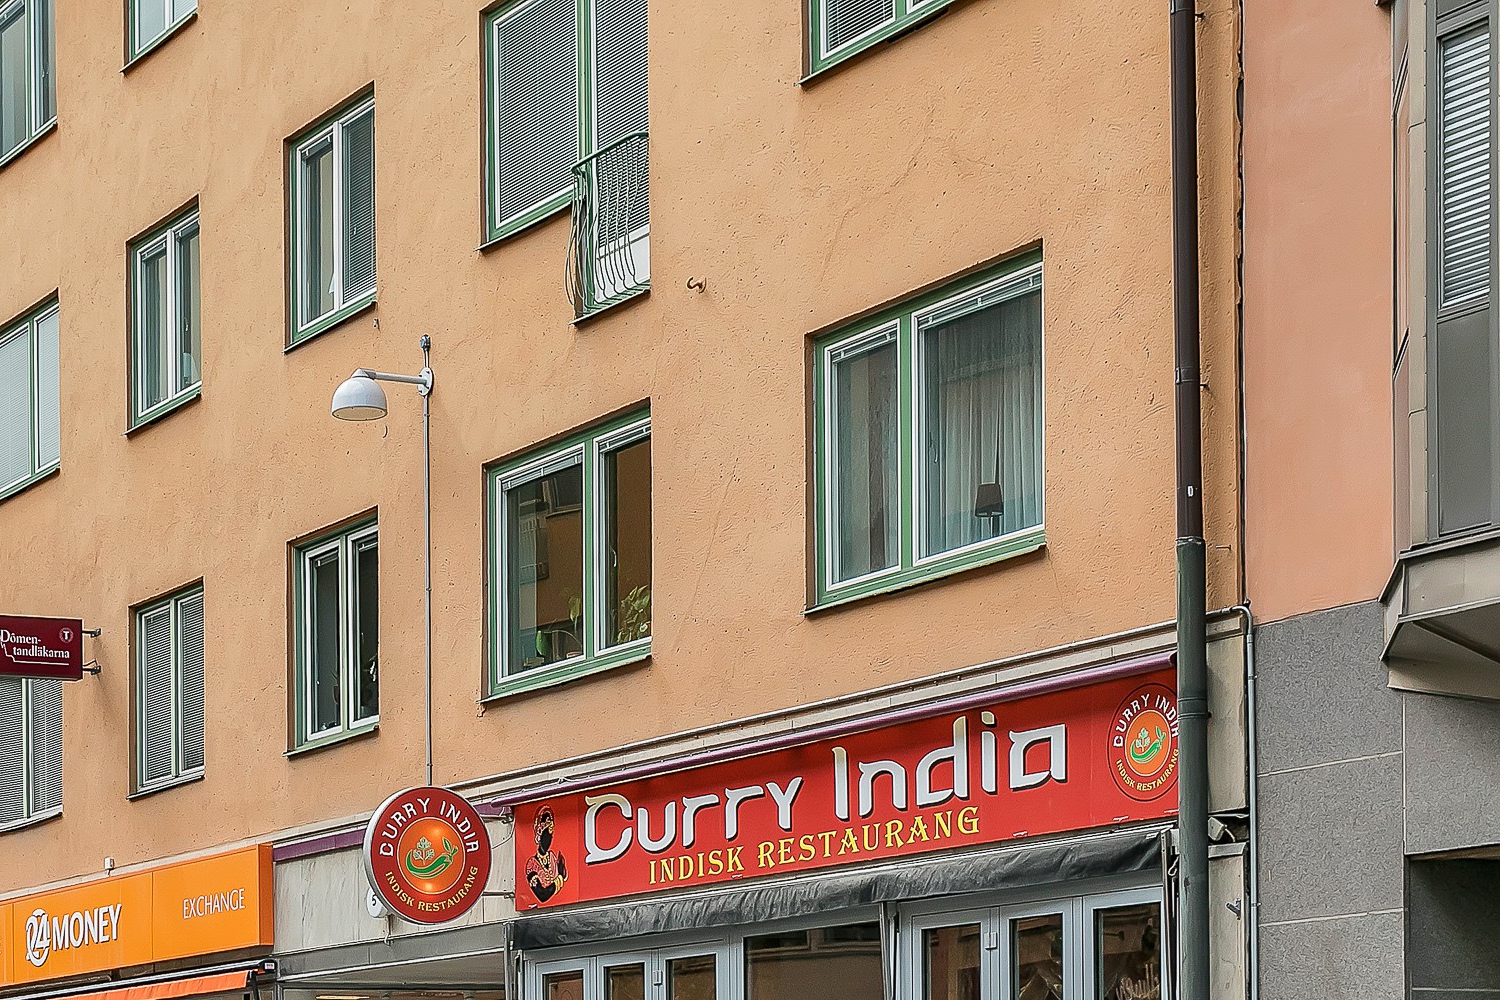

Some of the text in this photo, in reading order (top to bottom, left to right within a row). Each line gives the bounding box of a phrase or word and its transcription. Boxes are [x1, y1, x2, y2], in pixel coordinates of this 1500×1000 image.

[13, 645, 70, 658] tandläkarna
[584, 710, 1067, 864] Curry India
[1117, 759, 1135, 788] INDISK
[649, 806, 981, 885] INDISK RESTAURANG
[183, 888, 246, 919] EXCHANGE
[385, 866, 478, 912] INDISK RESTAURANG
[51, 904, 122, 951] MONEY
